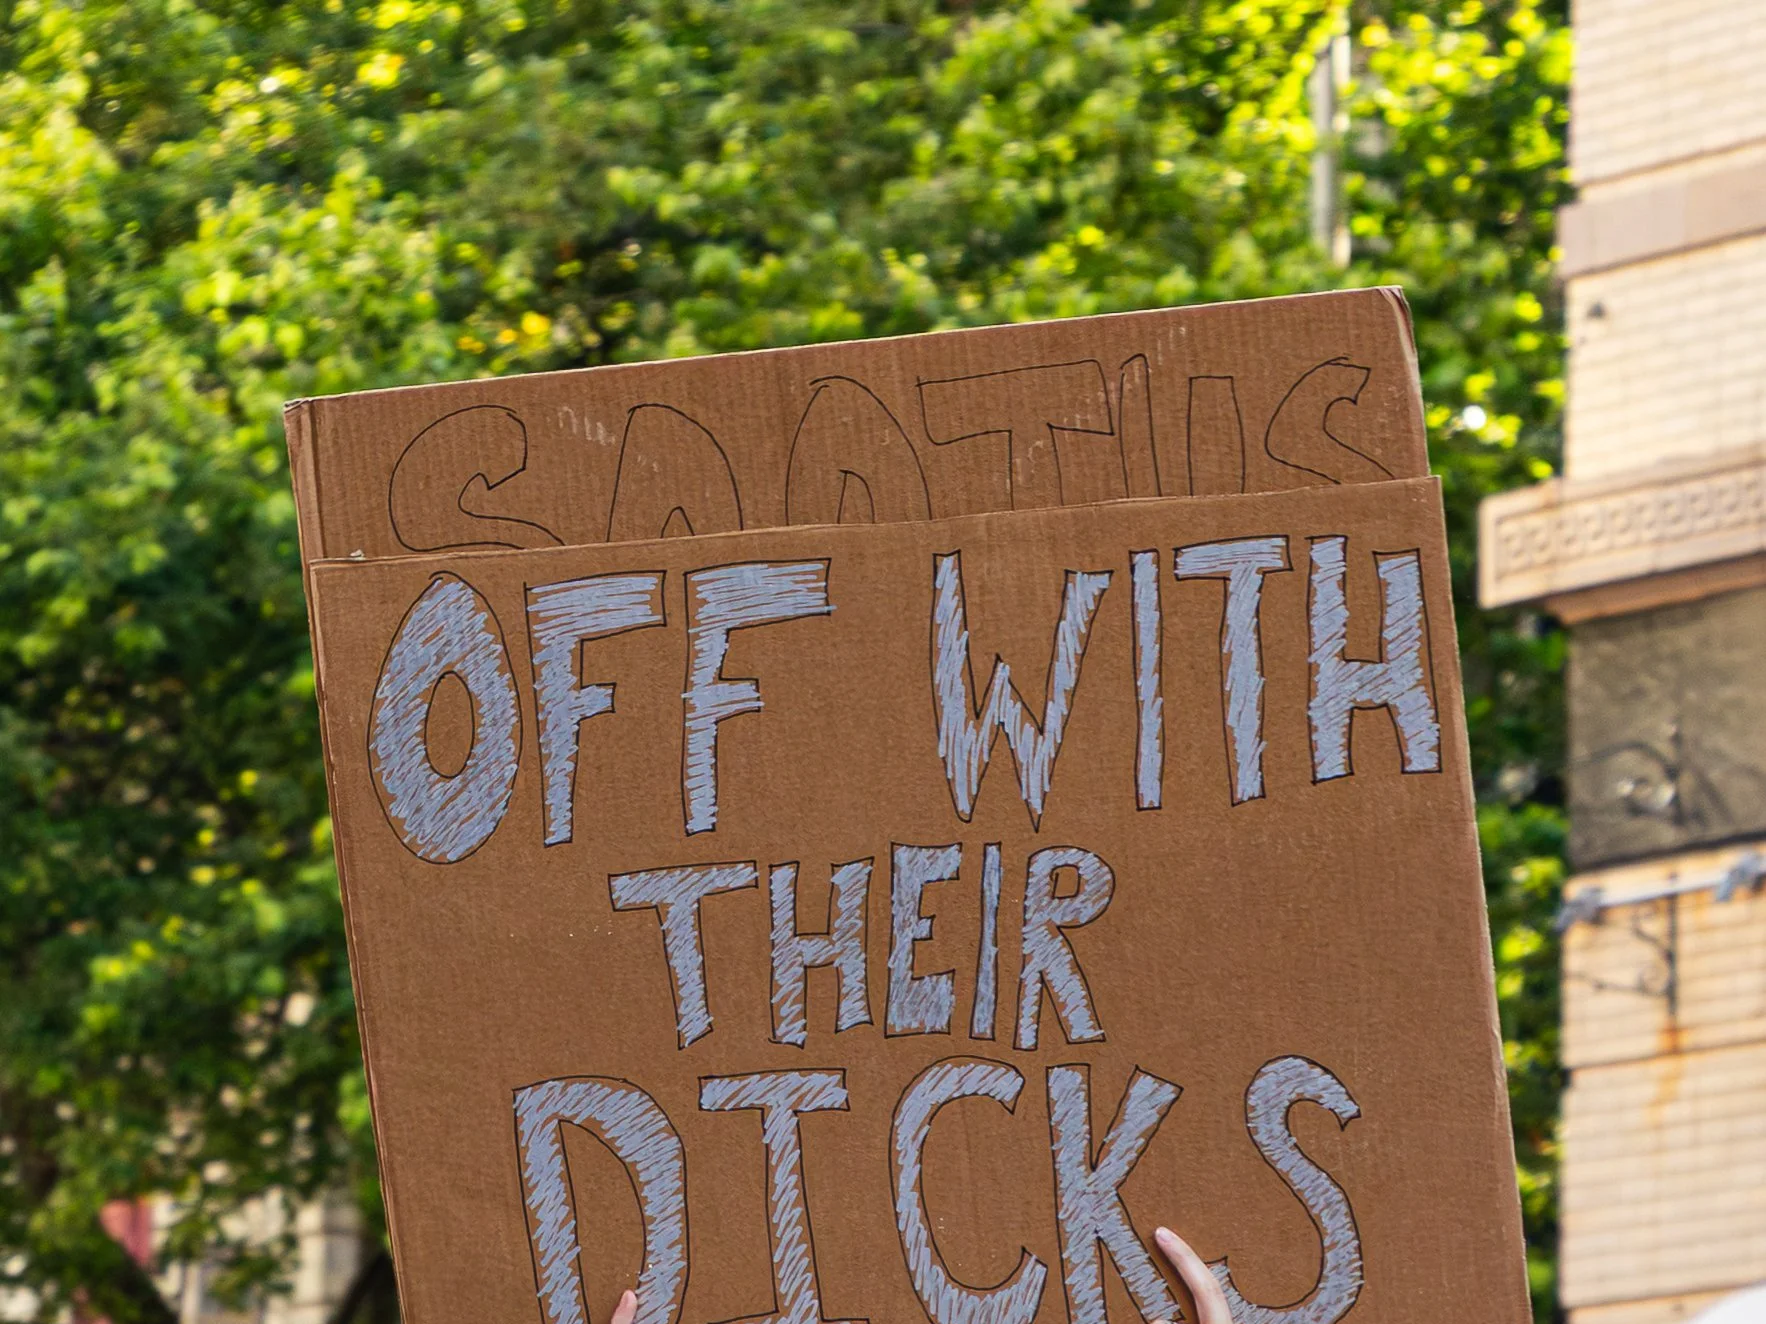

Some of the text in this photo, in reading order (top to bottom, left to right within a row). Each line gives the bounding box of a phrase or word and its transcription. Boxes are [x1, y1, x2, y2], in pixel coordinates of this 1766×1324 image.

[367, 534, 1442, 864] OFF WITH
[608, 842, 1116, 1051] THEIR
